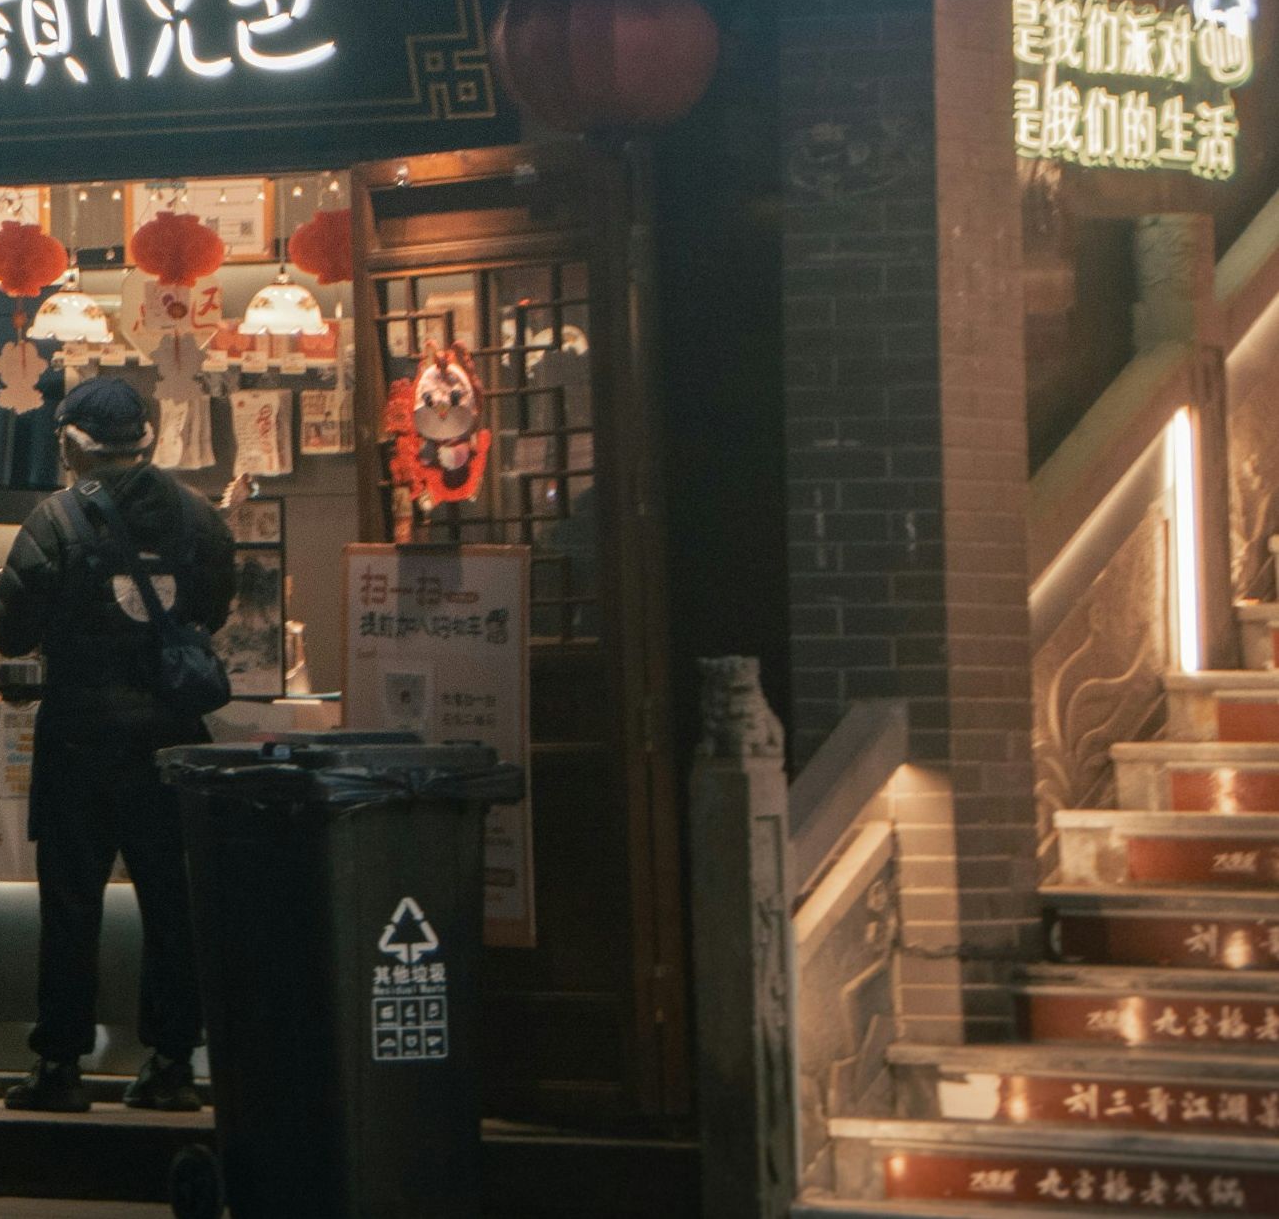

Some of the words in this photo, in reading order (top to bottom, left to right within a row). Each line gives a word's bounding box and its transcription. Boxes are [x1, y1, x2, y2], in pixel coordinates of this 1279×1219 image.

[1013, 80, 1238, 180] 是我们的生活
[372, 962, 447, 985] 其他垃圾
